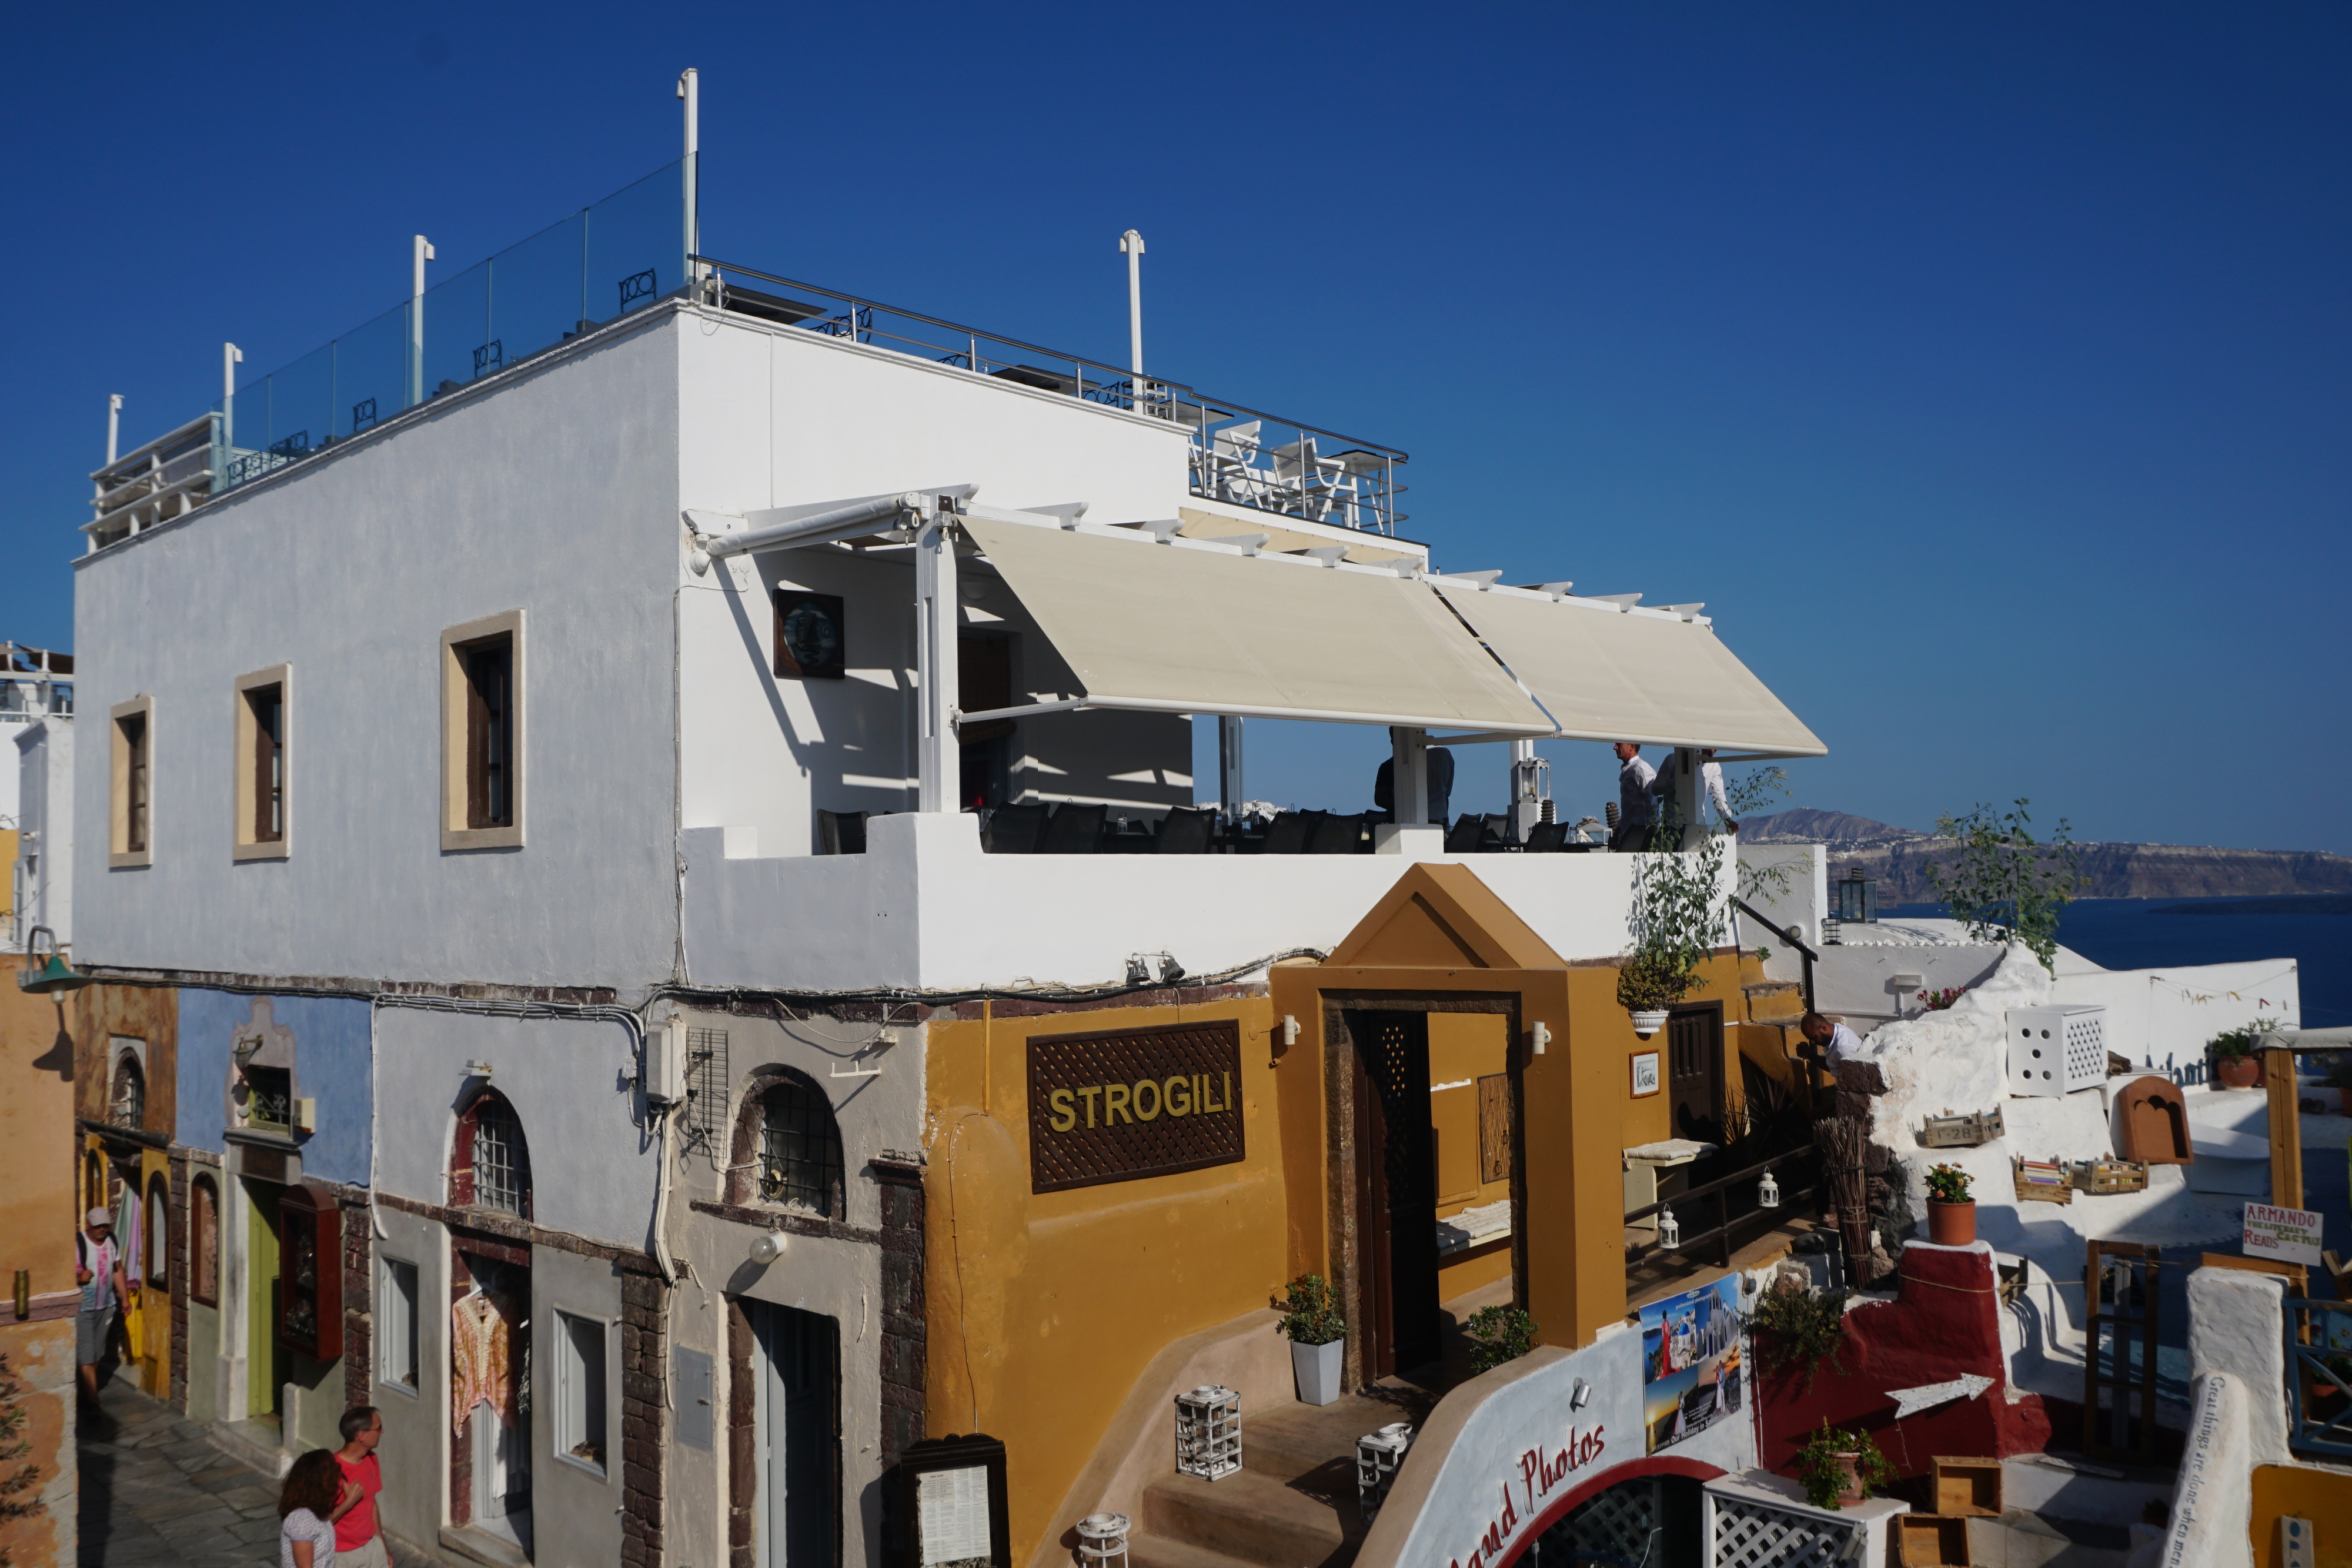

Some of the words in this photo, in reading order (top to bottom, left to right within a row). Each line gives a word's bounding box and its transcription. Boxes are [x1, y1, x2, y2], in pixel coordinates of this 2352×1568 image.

[1049, 1071, 1231, 1132] STROGILI
[2246, 1205, 2316, 1228] ARMANDO
[2246, 1220, 2263, 1229] THE
[2276, 1232, 2321, 1246] CACTUS
[2207, 1376, 2226, 1409] Great
[1671, 1435, 1681, 1443] Our
[1681, 1425, 1699, 1439] Holiday
[1705, 1412, 1725, 1427] Santorini
[2196, 1412, 2219, 1449] things
[1516, 1425, 1605, 1515] Photos
[2193, 1453, 2206, 1471] are
[2185, 1475, 2205, 1505] done
[2176, 1507, 2196, 1539] when
[2169, 1540, 2185, 1566] men
